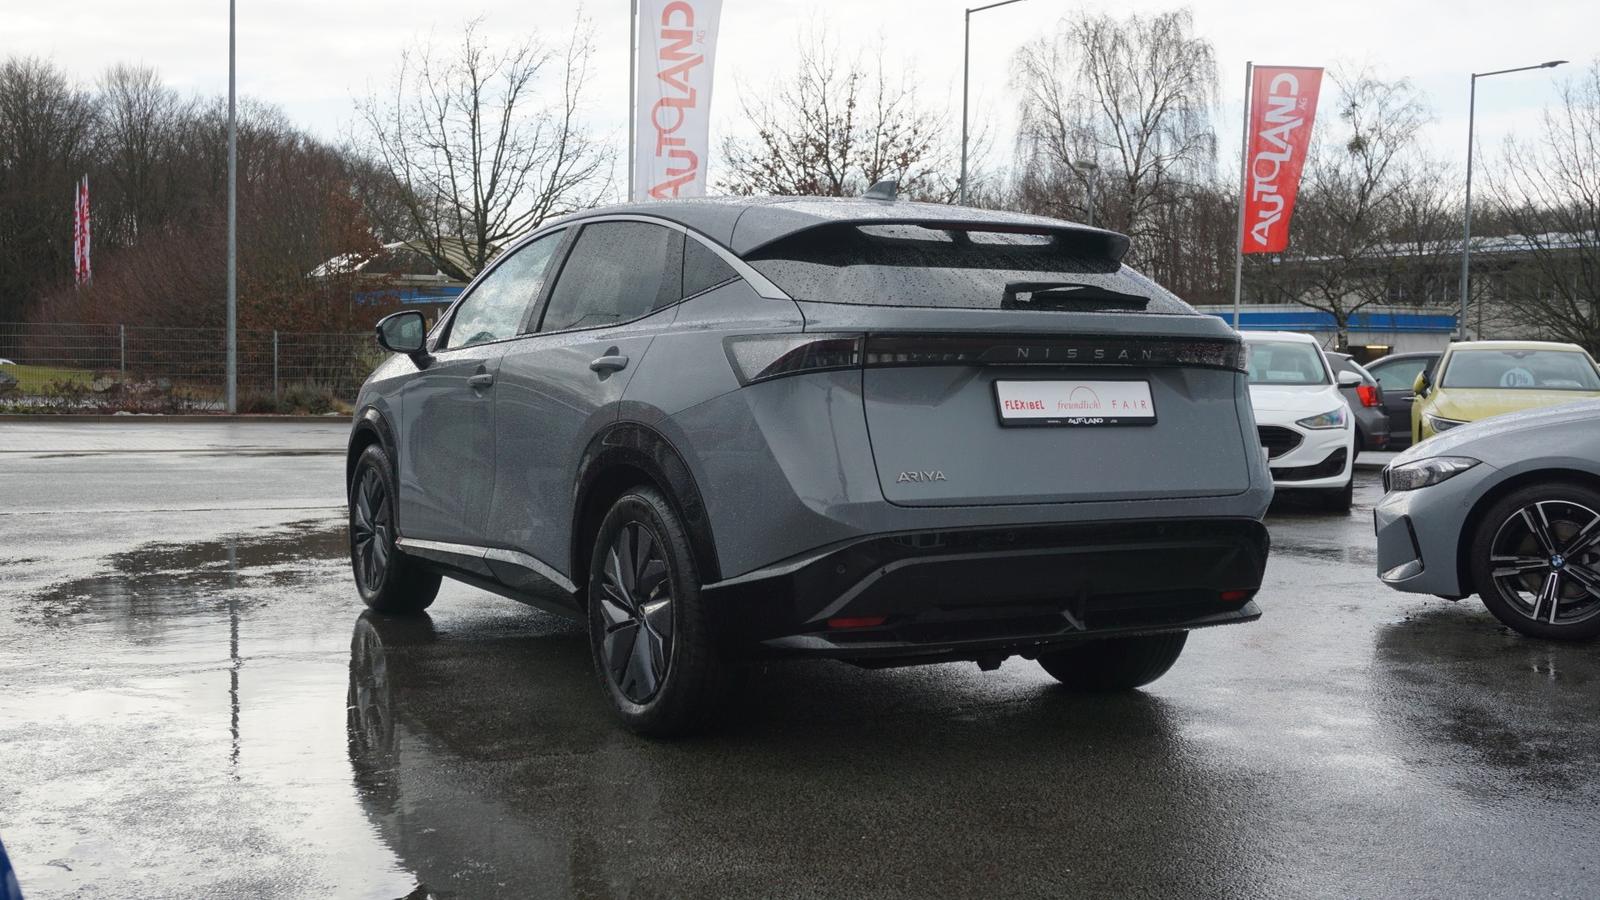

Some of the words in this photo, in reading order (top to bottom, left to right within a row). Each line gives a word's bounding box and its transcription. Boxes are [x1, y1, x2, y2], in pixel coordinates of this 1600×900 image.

[647, 0, 704, 200] AUTOLAND
[1298, 97, 1308, 111] AG
[1250, 72, 1304, 246] AUTOLAND
[1017, 347, 1152, 360] NISSAN
[1005, 399, 1045, 410] FLEXIBEL
[1057, 399, 1098, 410] freundlich
[1111, 399, 1147, 410] FAIR
[898, 471, 946, 481] ARIYA
